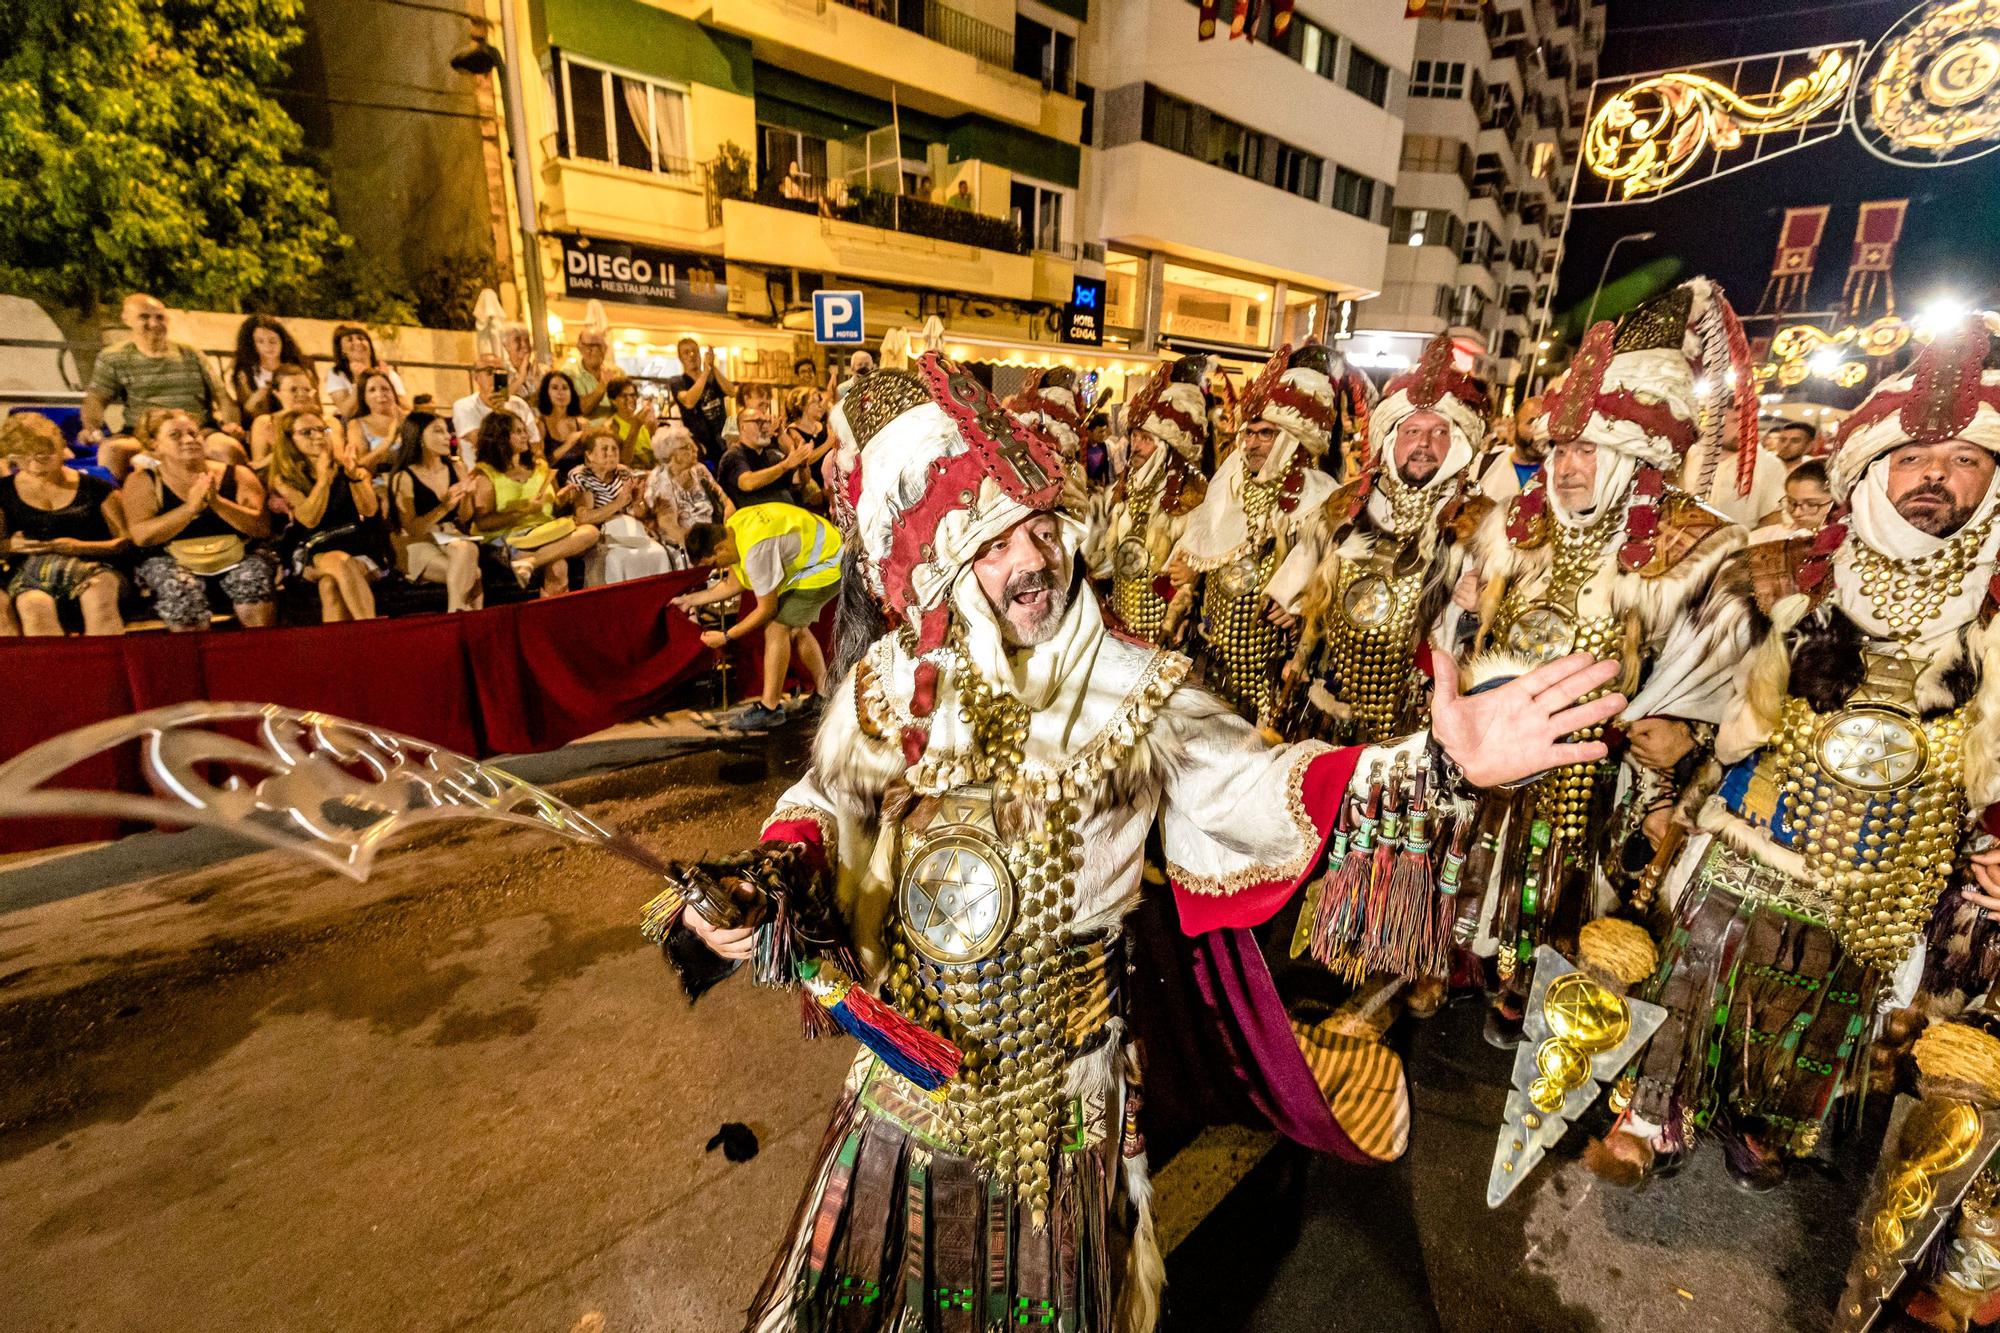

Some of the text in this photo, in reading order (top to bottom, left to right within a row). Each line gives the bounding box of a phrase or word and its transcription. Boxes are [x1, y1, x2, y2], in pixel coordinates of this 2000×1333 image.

[567, 249, 676, 287] DIEGO II
[569, 276, 593, 290] BAR
[601, 280, 676, 299] RESTAURANTE
[823, 297, 853, 338] P
[1073, 314, 1095, 328] HOTEL
[836, 330, 858, 338] MOTOS
